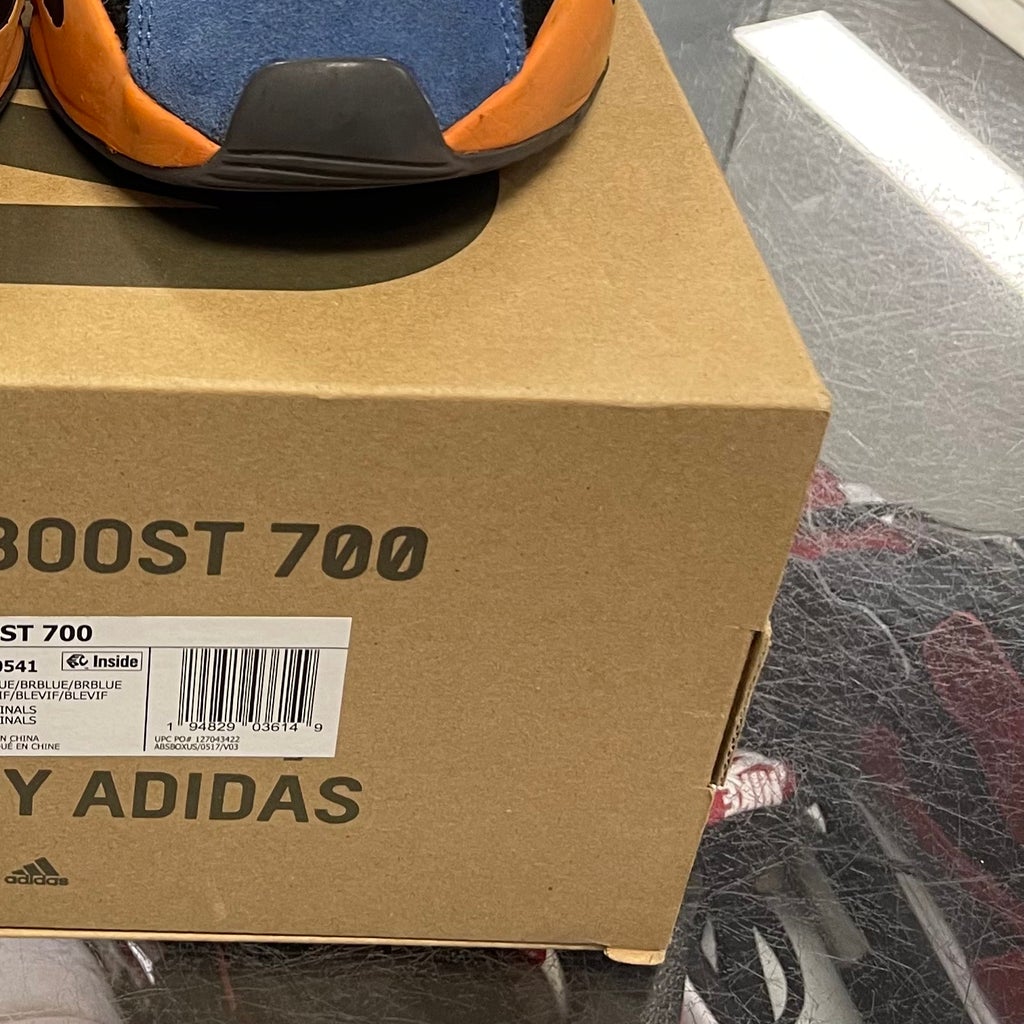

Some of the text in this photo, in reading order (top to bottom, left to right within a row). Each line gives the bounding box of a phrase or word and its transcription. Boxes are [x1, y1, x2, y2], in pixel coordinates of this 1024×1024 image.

[271, 523, 429, 581] 700
[42, 624, 93, 642] 700
[93, 654, 138, 668] Inside
[167, 721, 323, 732] 1 94829 03614 9
[9, 735, 39, 743] CHINA
[32, 743, 60, 751] CHINE
[72, 770, 363, 825] ADIDAS
[4, 873, 69, 886] adidas
